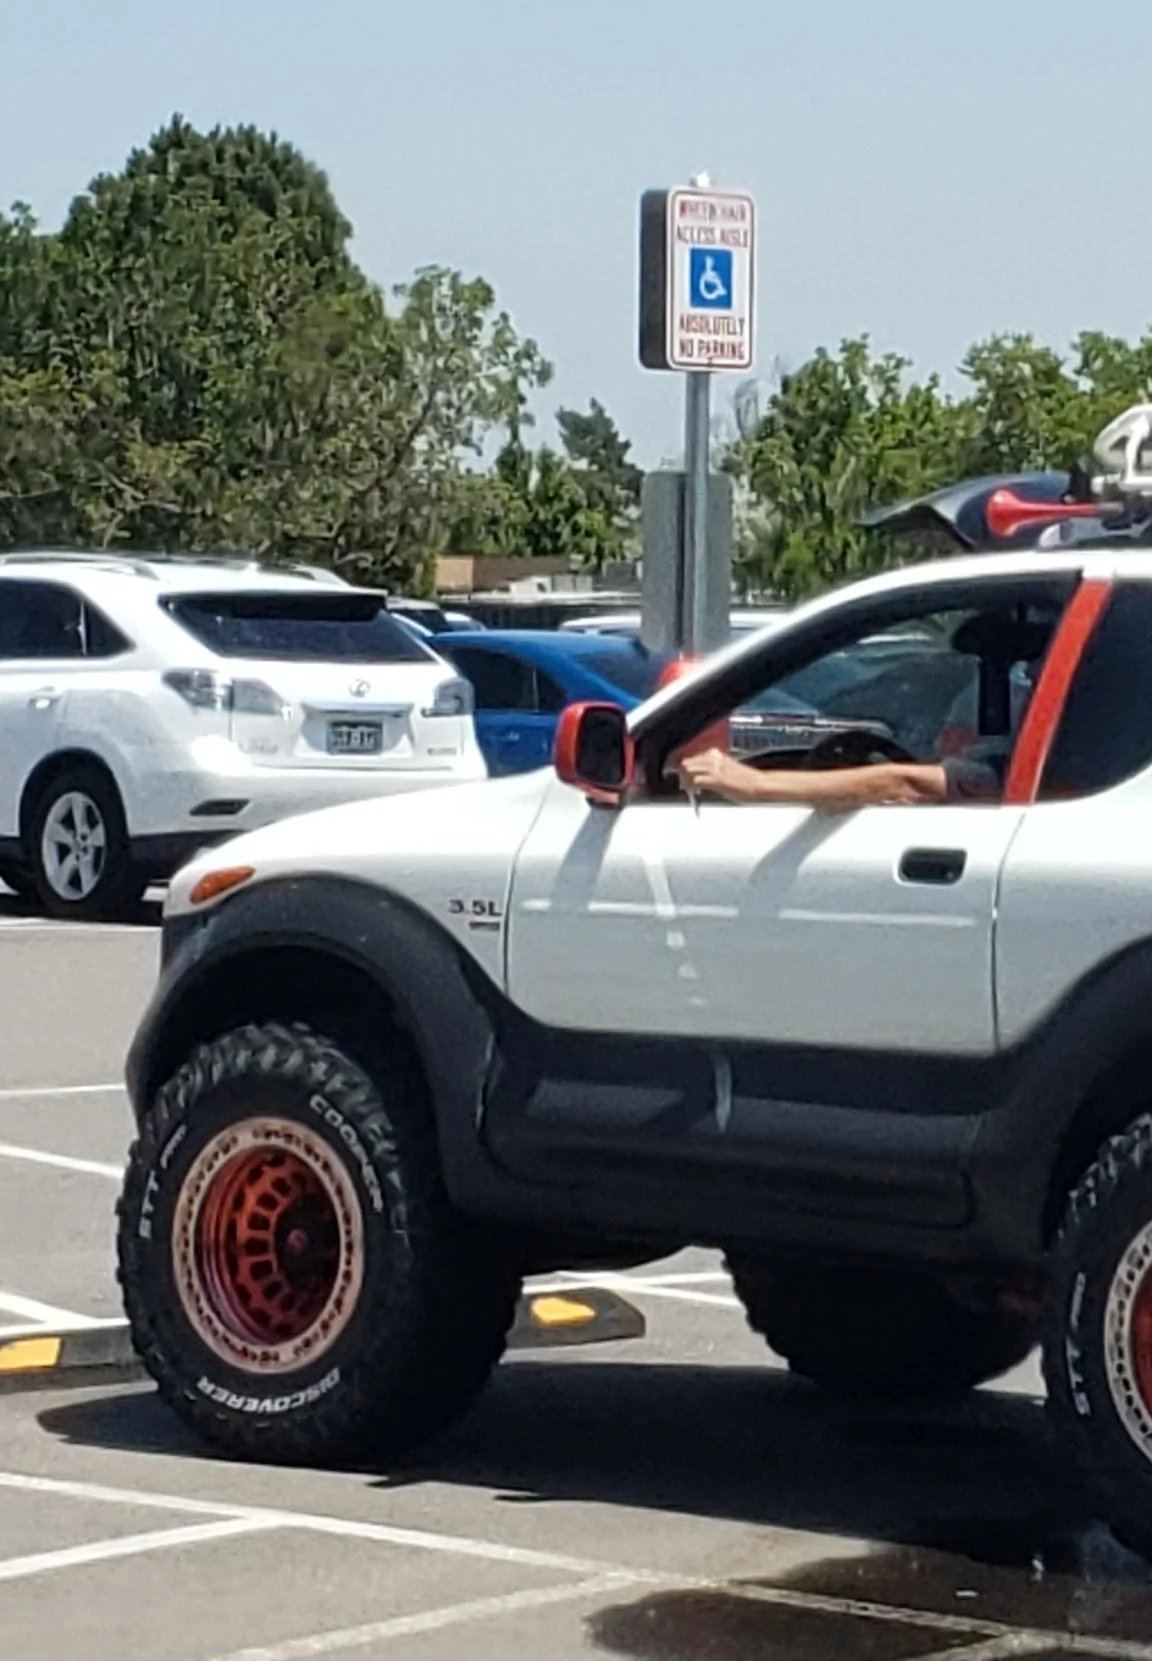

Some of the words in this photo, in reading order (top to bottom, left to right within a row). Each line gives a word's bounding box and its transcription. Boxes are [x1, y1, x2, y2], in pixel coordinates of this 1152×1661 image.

[679, 313, 745, 337] ABSOLUTELY
[679, 338, 694, 358] NO
[309, 1094, 382, 1213] COOPER
[196, 1366, 340, 1414] DISCOVERER
